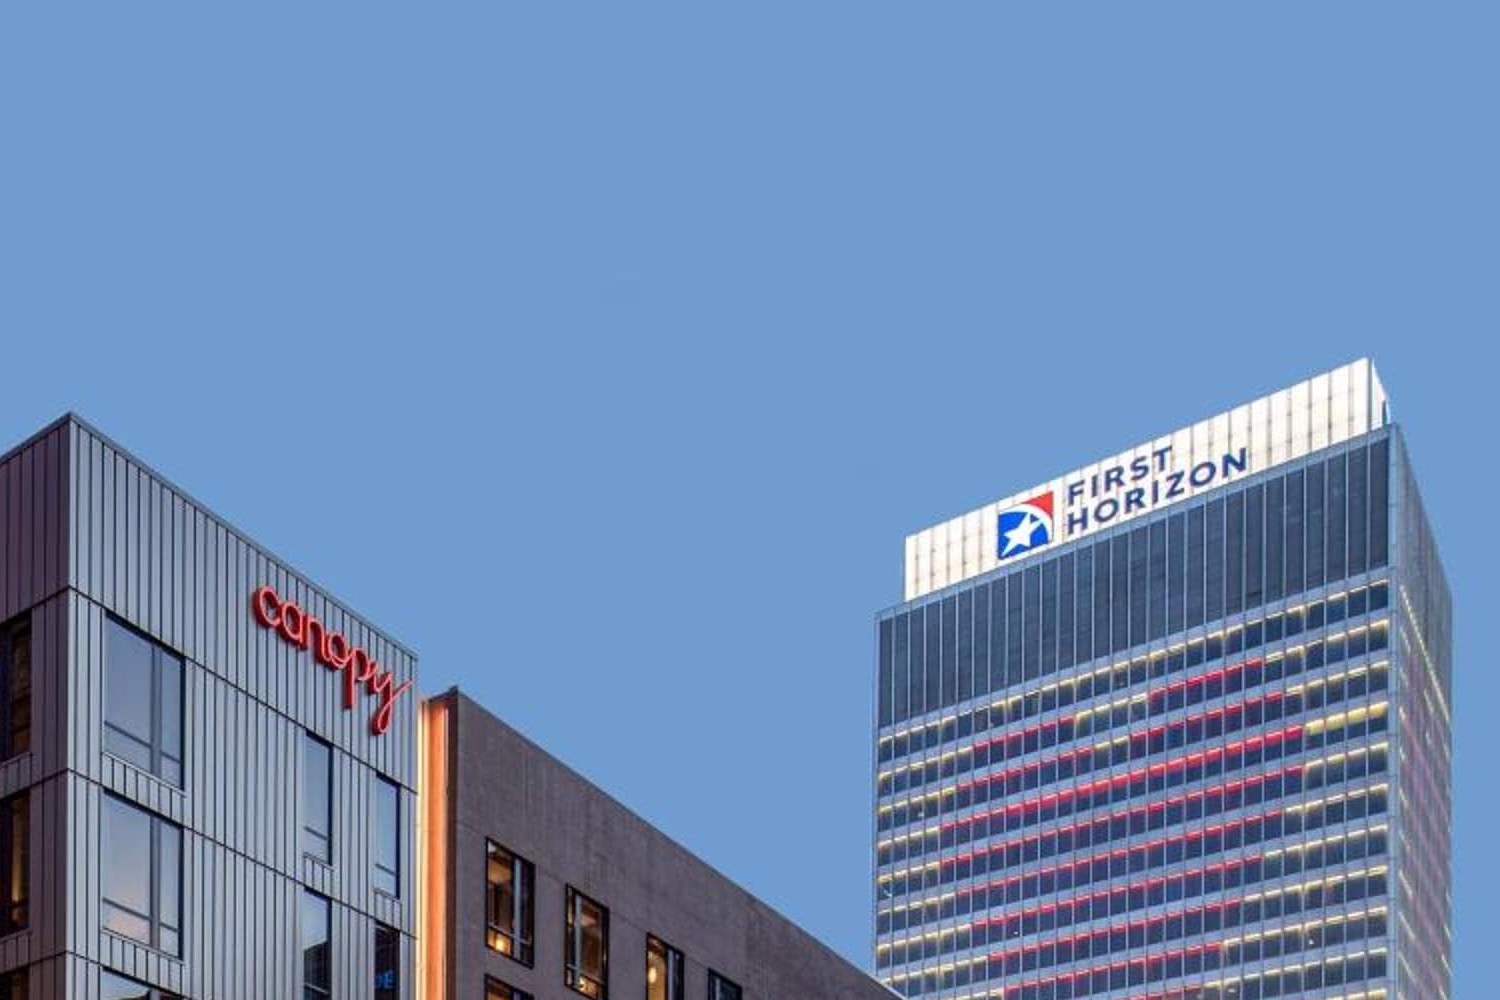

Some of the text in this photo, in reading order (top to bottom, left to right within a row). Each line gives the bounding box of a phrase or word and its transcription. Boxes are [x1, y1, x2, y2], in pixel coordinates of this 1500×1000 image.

[1066, 447, 1248, 534] HORIZON
[1067, 445, 1174, 505] FIRST
[252, 586, 417, 736] canopy
